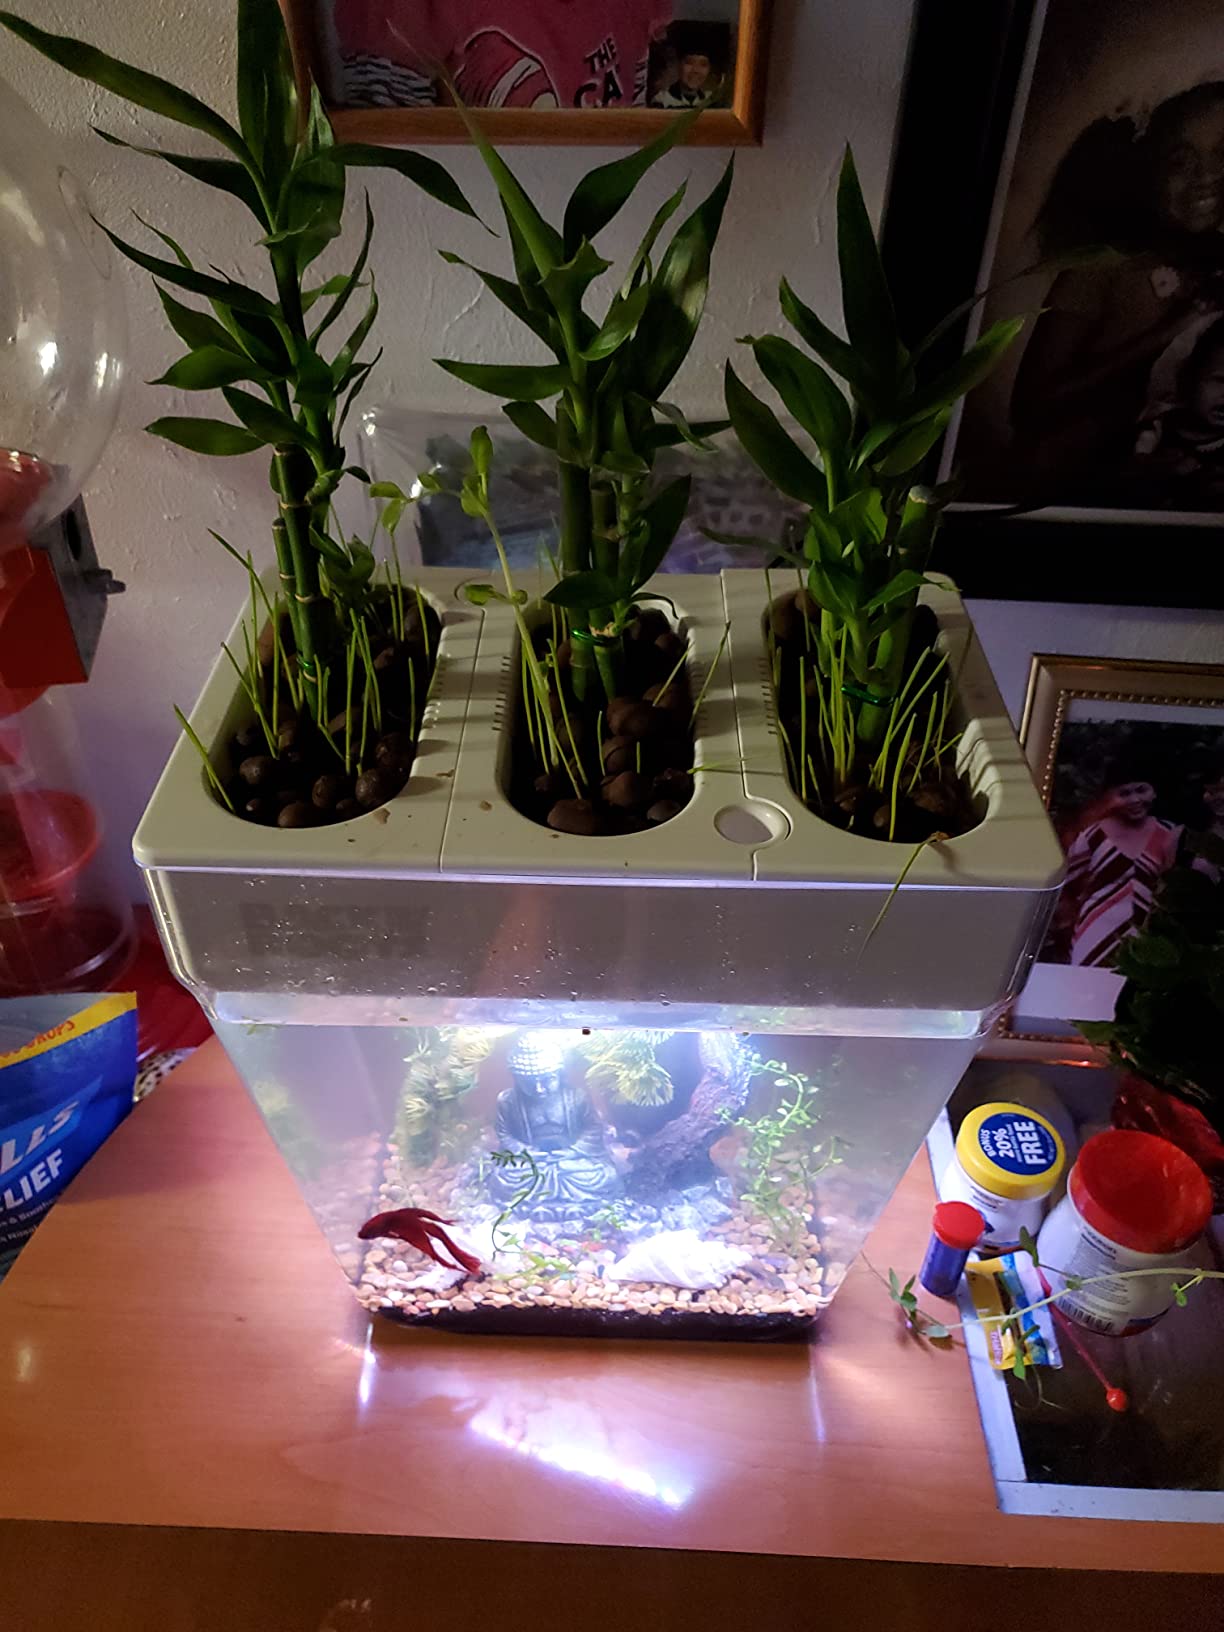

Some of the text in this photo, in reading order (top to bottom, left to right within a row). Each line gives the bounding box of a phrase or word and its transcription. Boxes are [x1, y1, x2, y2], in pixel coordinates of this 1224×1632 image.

[582, 36, 617, 73] THE
[980, 1128, 997, 1157] BONUS
[991, 1127, 1015, 1158] 20%
[1012, 1121, 1047, 1165] FREE
[0, 1148, 63, 1212] LIEF
